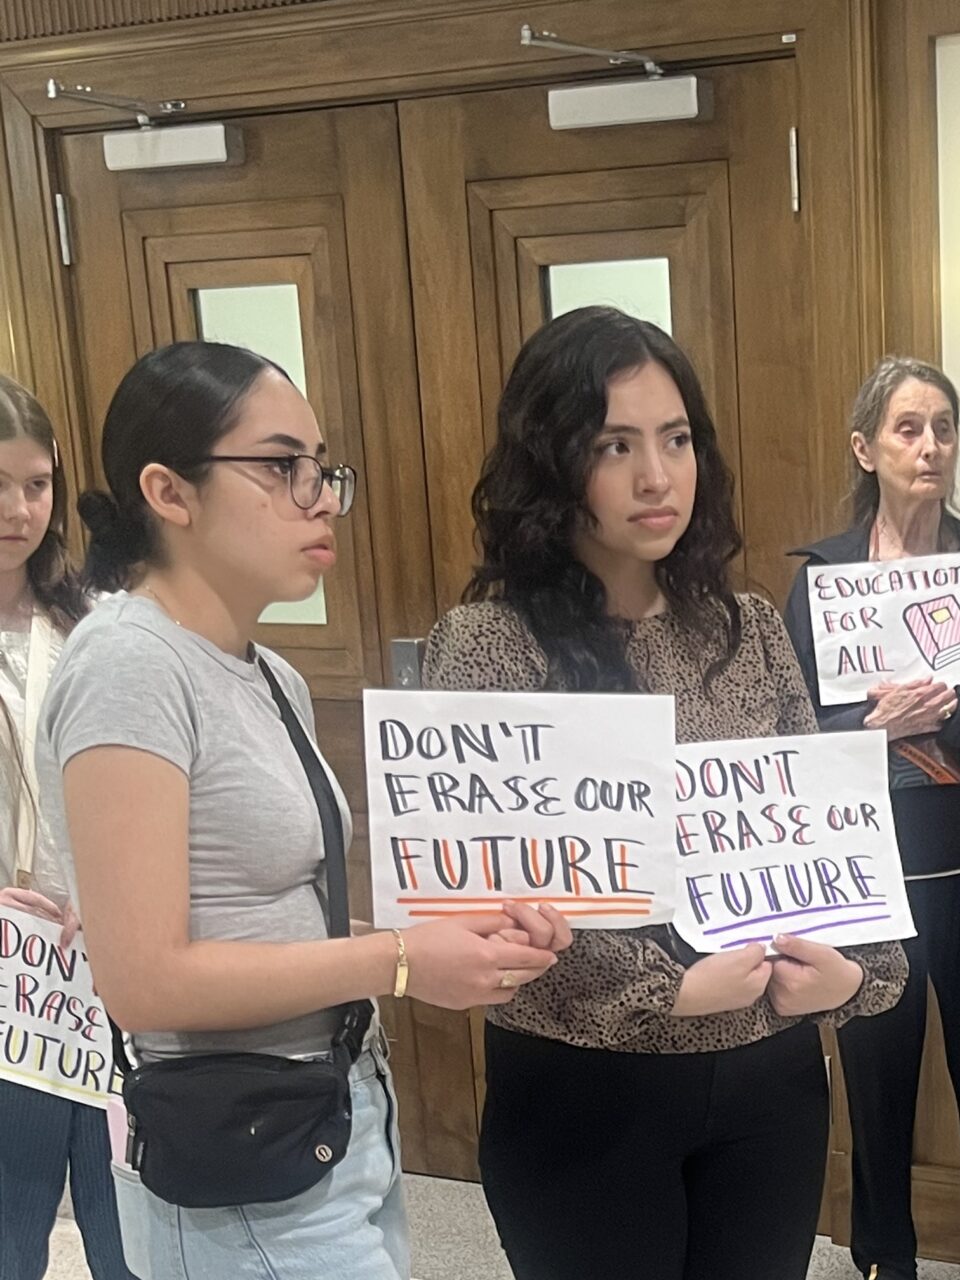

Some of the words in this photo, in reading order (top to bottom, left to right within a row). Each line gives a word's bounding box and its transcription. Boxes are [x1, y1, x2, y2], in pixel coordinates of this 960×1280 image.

[823, 607, 883, 634] FOR
[837, 645, 895, 675] ALL
[379, 719, 555, 764] DON'T
[385, 772, 566, 816] ERASE
[574, 777, 654, 817] OUR
[676, 750, 800, 803] DON'T
[676, 803, 815, 856] ERASE
[826, 803, 880, 831] OUR
[390, 835, 655, 896] FUTURE
[686, 855, 886, 924] FUTURE
[0, 918, 88, 982] DON'
[0, 966, 104, 1042] RASE
[0, 1020, 124, 1097] UTURE
